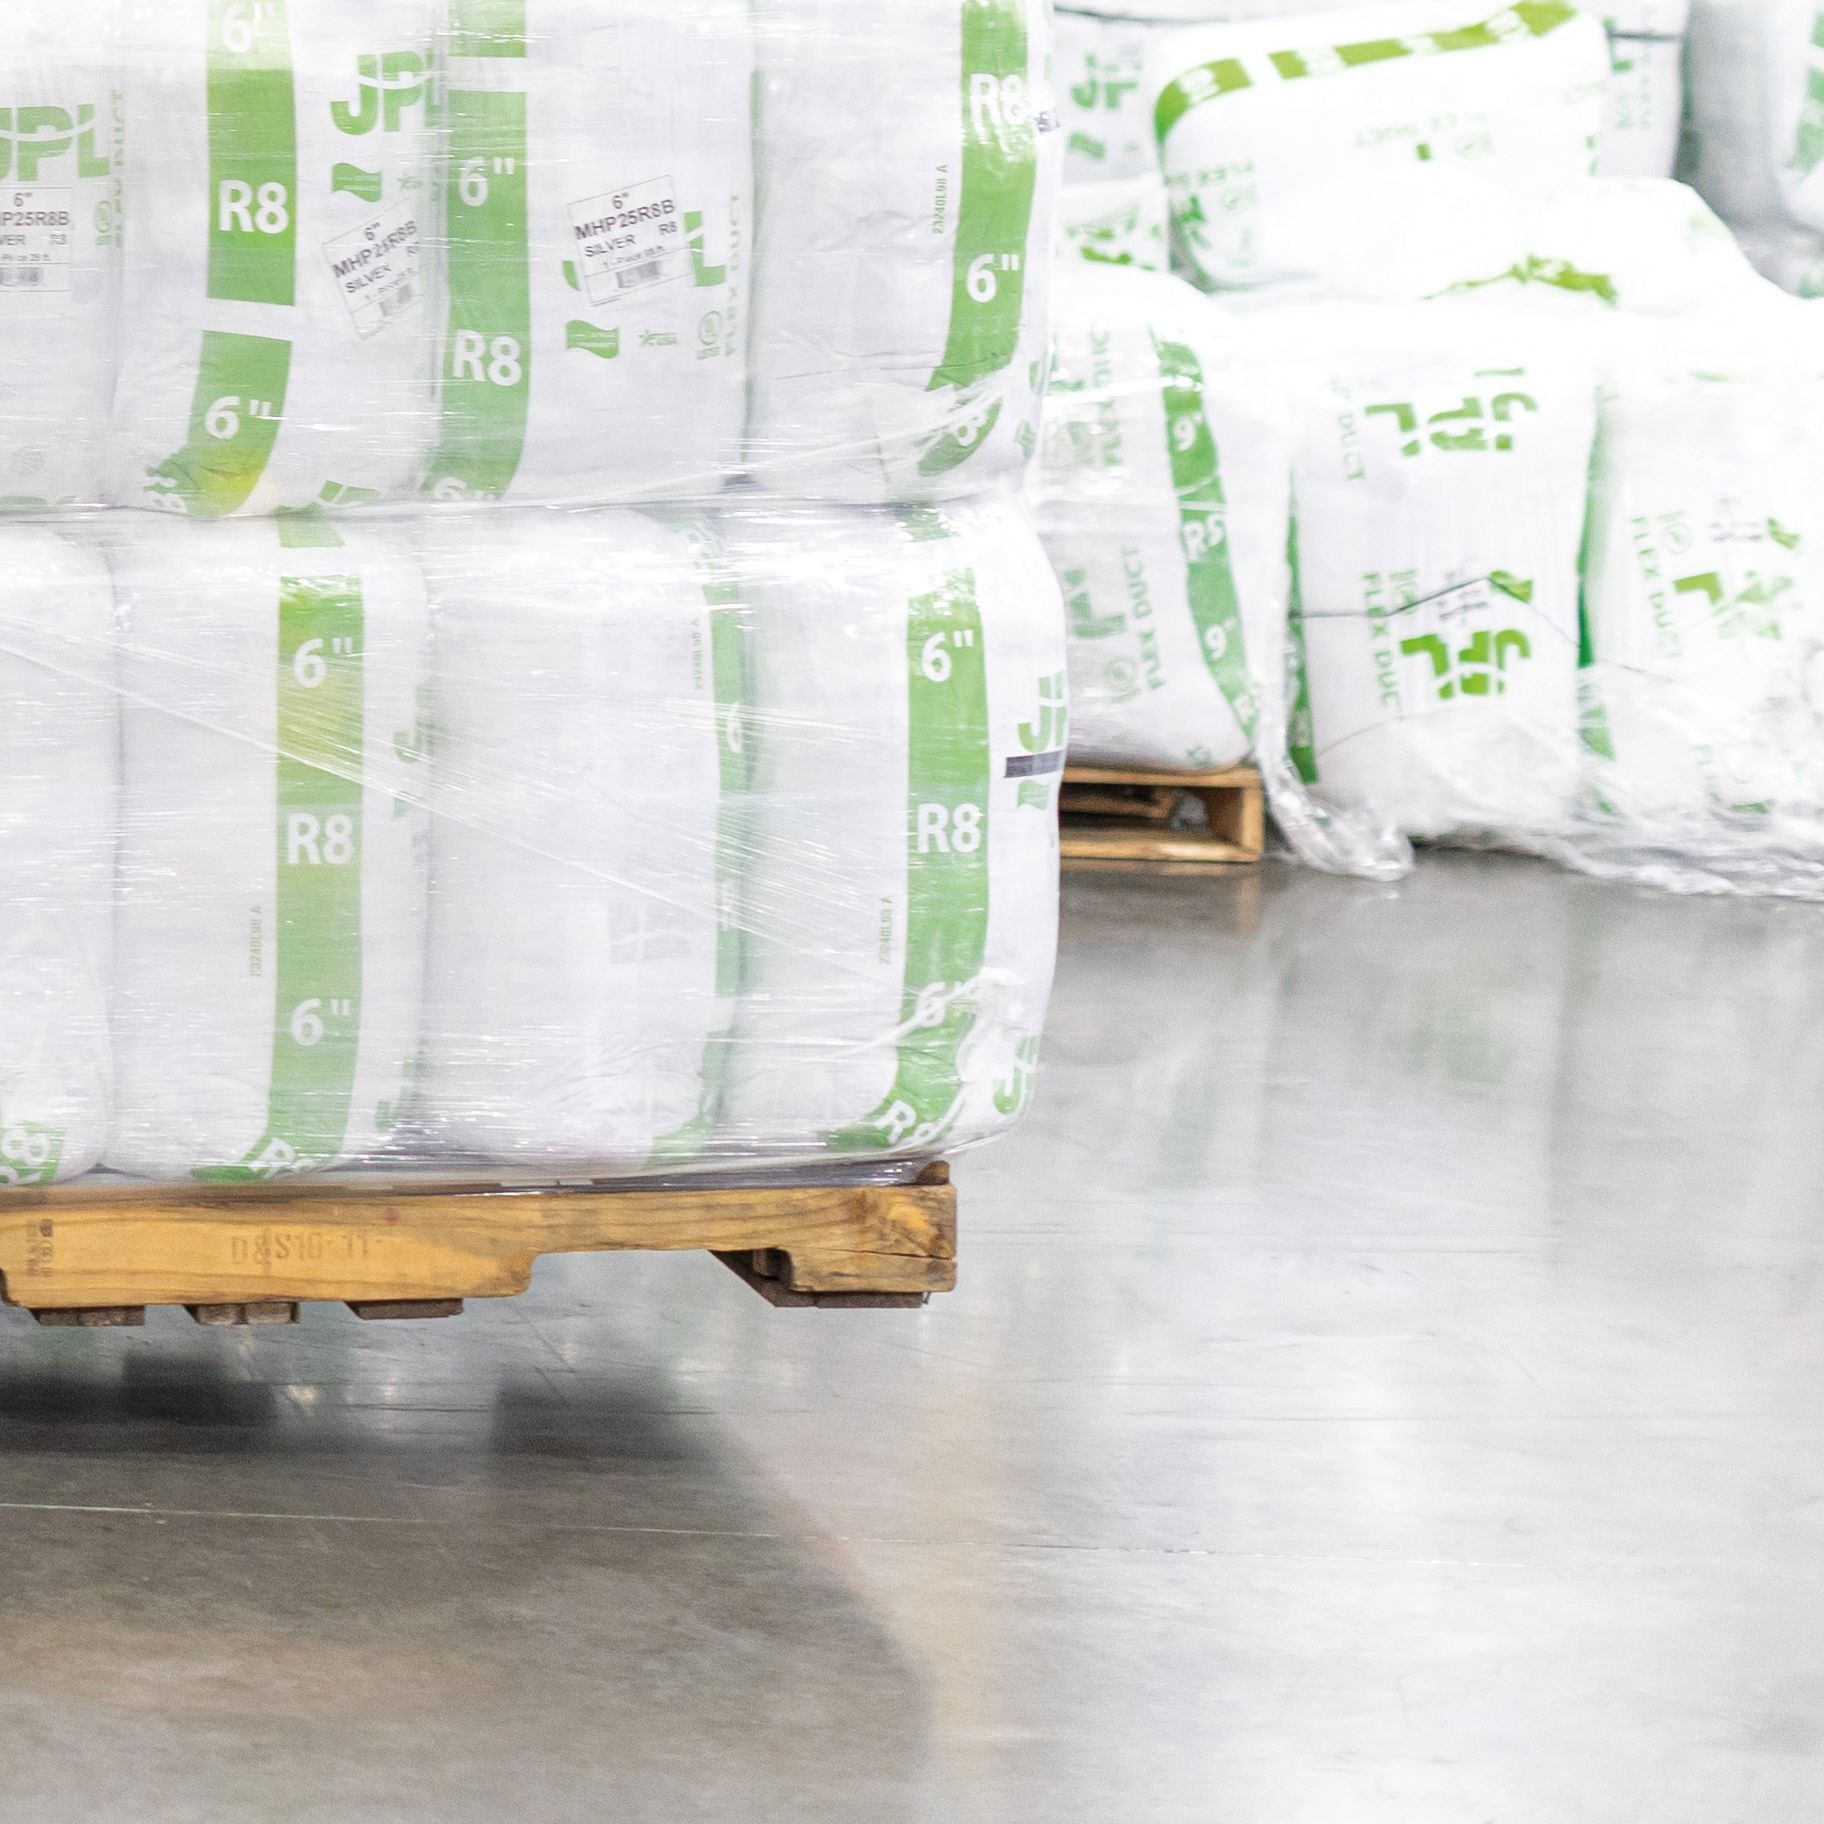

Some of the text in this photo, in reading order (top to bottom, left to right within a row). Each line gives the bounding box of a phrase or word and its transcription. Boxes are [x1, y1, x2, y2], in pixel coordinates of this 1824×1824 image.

[221, 2, 277, 54] 6"
[970, 73, 1032, 129] R8
[13, 191, 33, 207] 6"
[218, 180, 290, 236] R8
[457, 157, 515, 208] 6"
[612, 191, 630, 210] 6"
[364, 221, 381, 241] 6"
[574, 198, 676, 241] MHP25R8B
[583, 234, 637, 258] SILVER
[966, 253, 1021, 305] 6"
[453, 328, 524, 387] R8
[204, 395, 273, 439] 6"
[1363, 392, 1538, 459] JPL
[293, 634, 355, 688] 6"
[920, 631, 973, 682] 6"
[1399, 628, 1533, 701] JPL
[286, 811, 357, 866] R8
[916, 803, 982, 854] R8
[289, 996, 350, 1047] 6"
